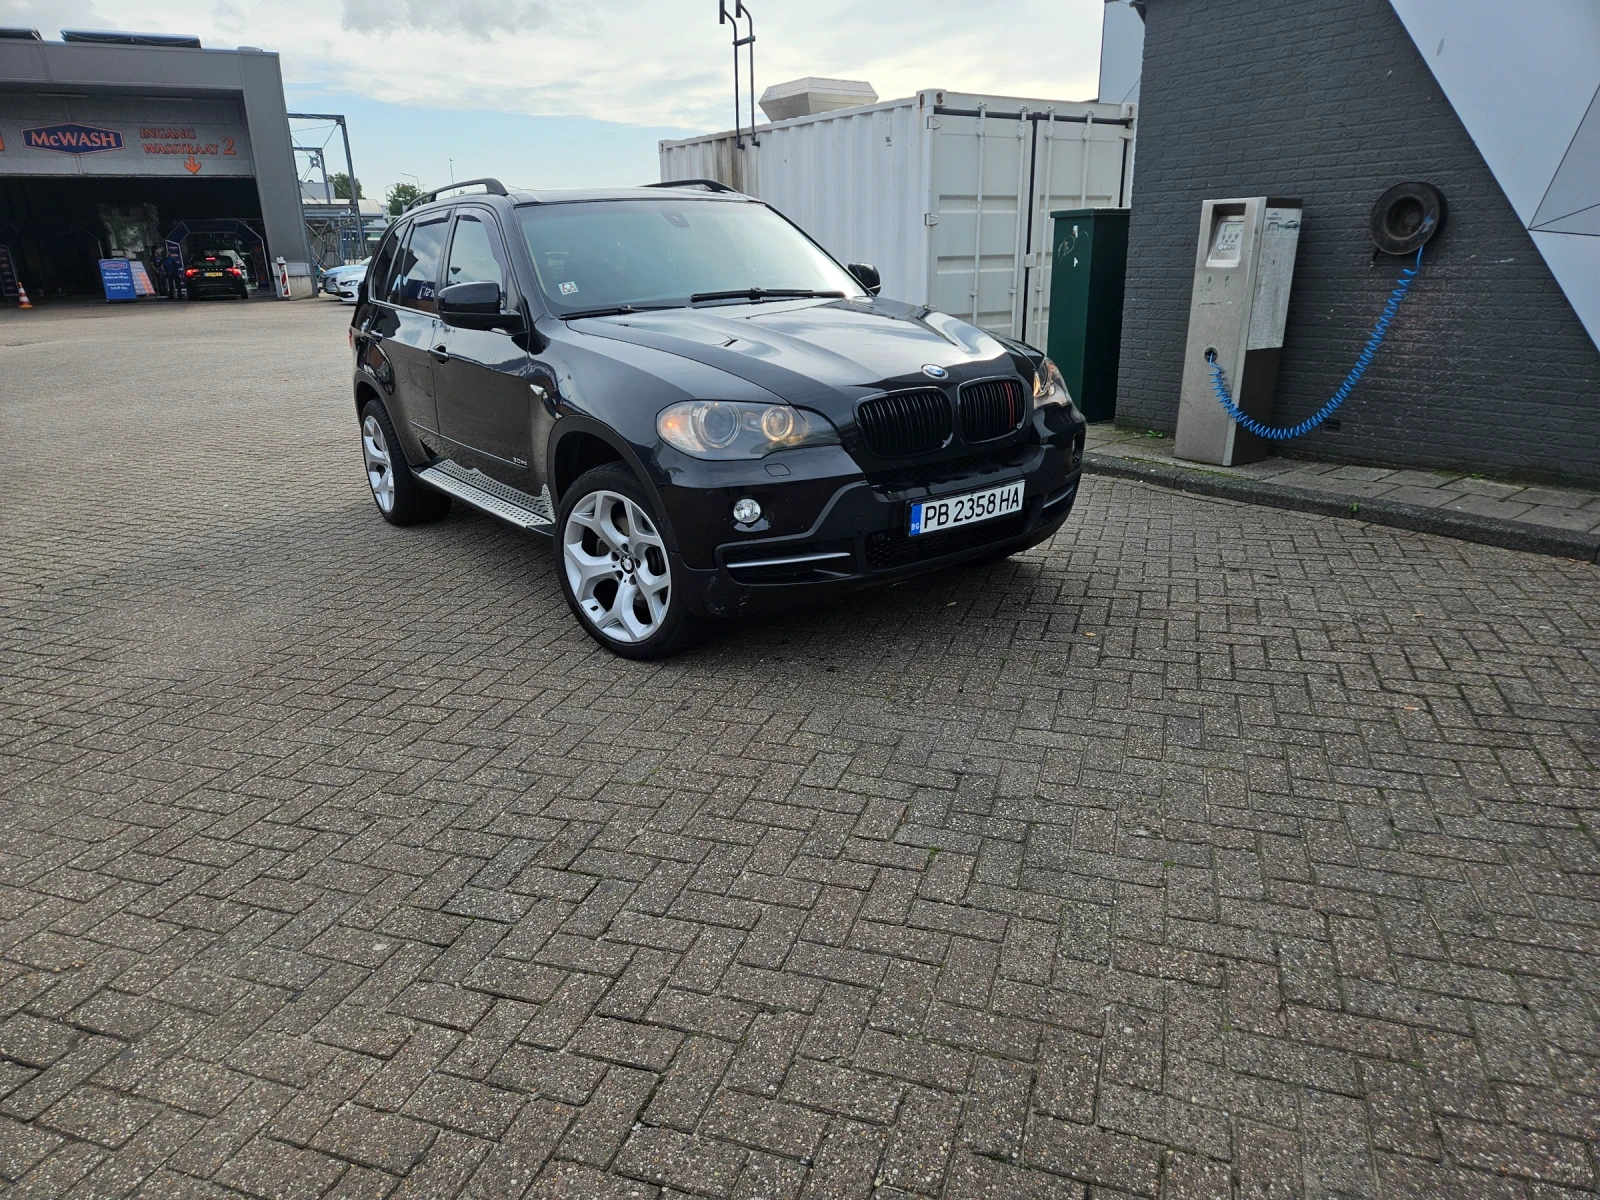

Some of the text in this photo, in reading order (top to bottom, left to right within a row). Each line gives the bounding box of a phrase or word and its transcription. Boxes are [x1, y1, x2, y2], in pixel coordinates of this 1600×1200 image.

[31, 131, 117, 147] McWASH
[140, 128, 196, 139] INGANG
[143, 136, 236, 155] WASSTRAAT 2
[924, 487, 1019, 529] PB 2358 HA
[911, 522, 920, 531] BG
